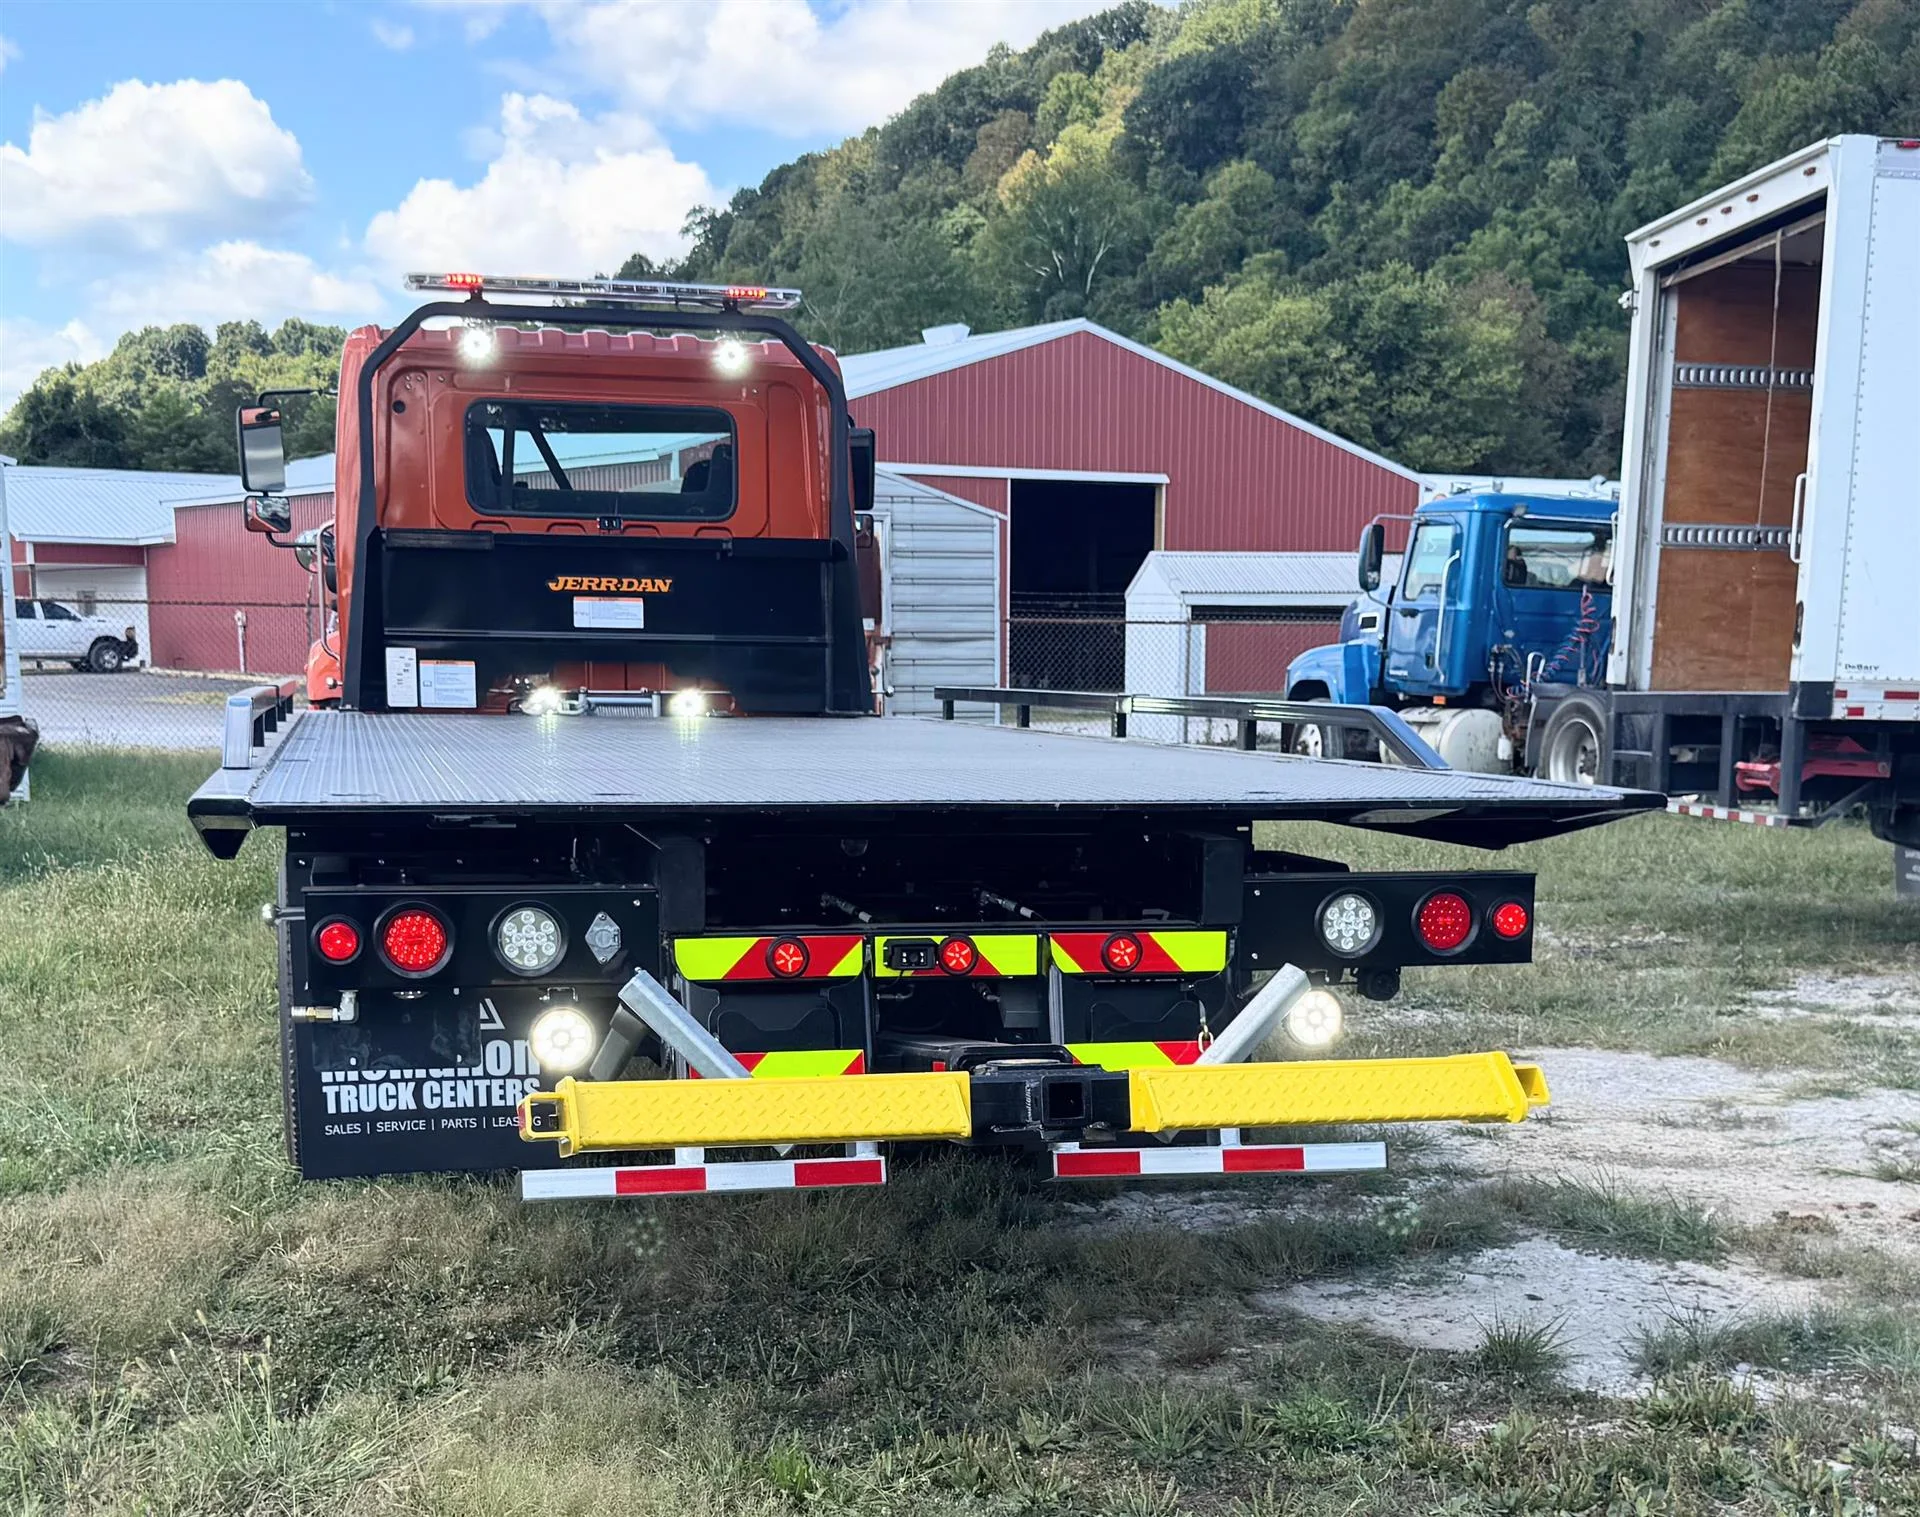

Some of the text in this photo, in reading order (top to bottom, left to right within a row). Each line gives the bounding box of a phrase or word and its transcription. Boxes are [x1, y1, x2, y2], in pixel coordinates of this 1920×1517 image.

[322, 1077, 541, 1114] TRUCK CENTERS
[324, 1115, 542, 1136] SALES SERVICE PARTS LEASG
